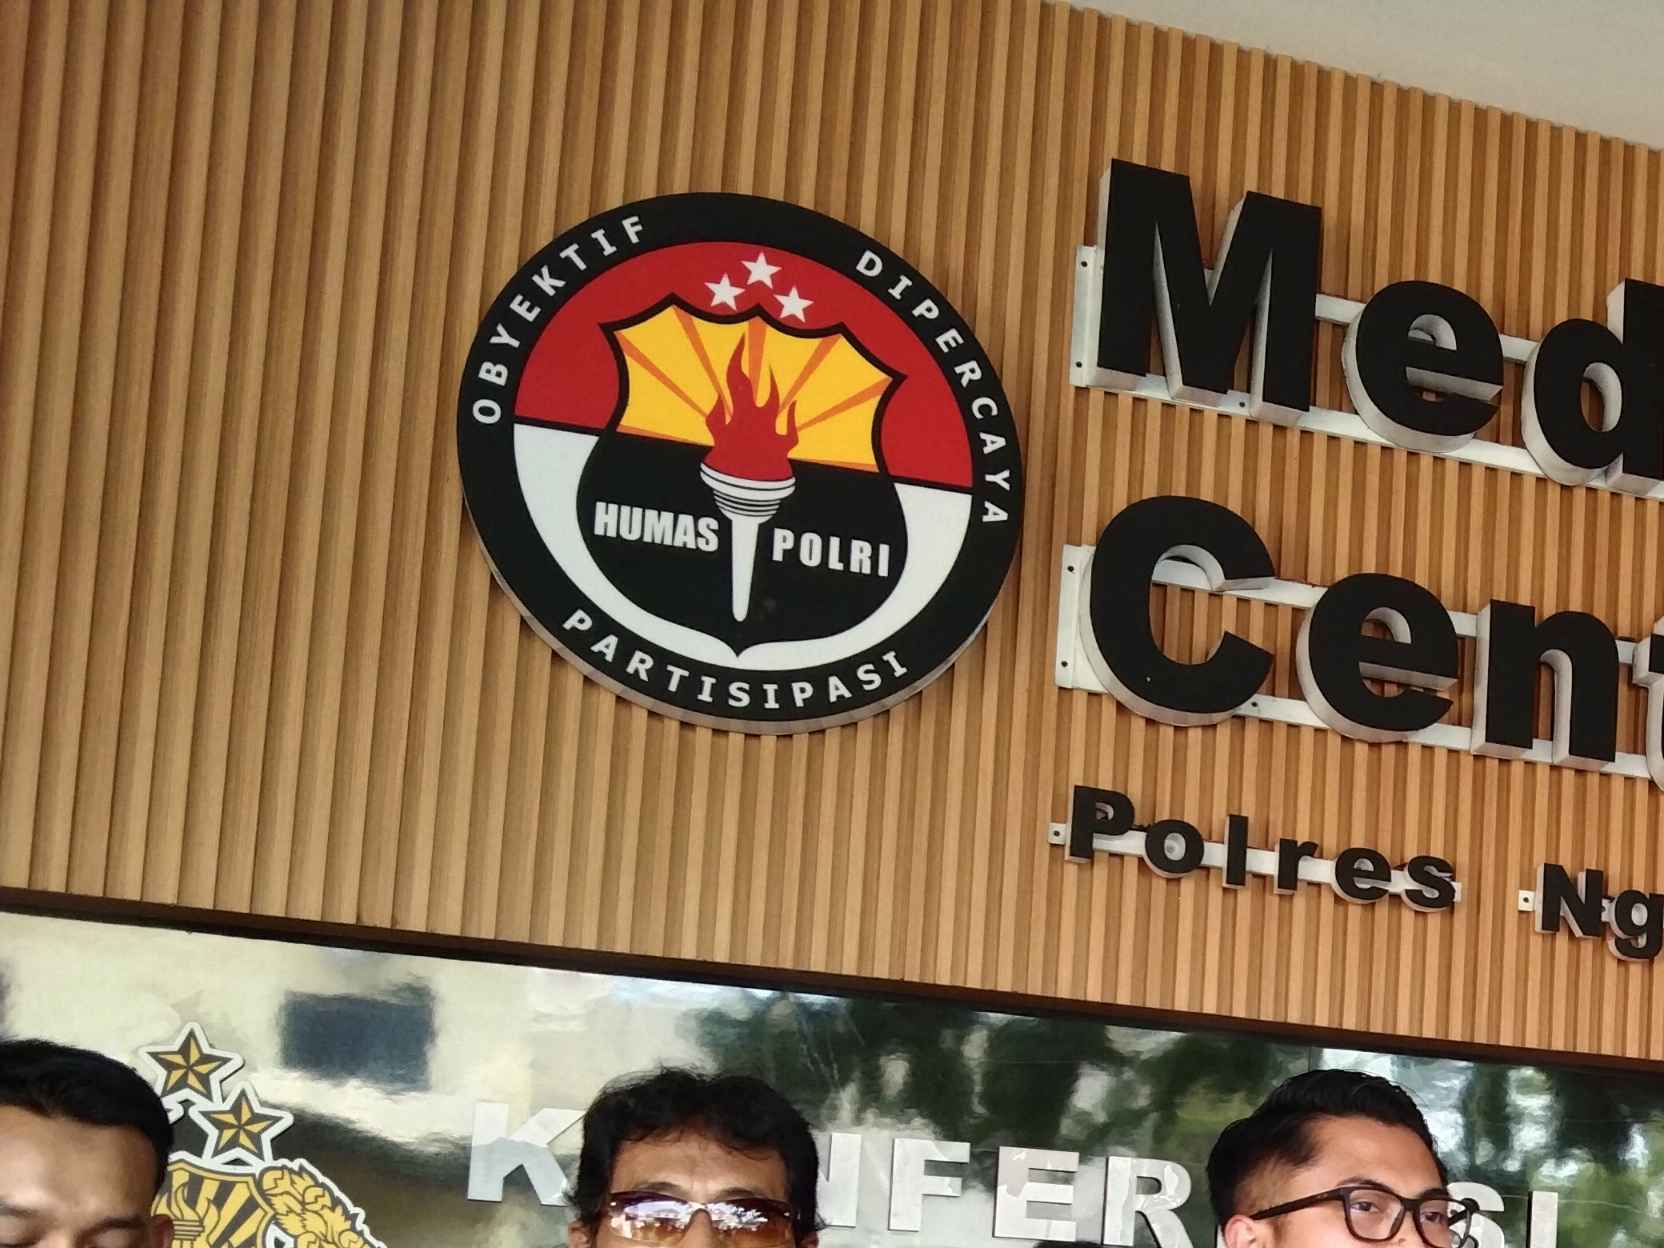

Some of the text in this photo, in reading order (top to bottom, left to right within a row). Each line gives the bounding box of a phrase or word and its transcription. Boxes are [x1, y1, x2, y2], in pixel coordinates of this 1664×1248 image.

[472, 215, 647, 425] OBYEKTIF
[855, 250, 1010, 526] DIPERCAYA
[593, 500, 890, 578] HUMAS POLRI
[562, 608, 908, 710] PARTISIPASI
[1064, 784, 1457, 914] Polres
